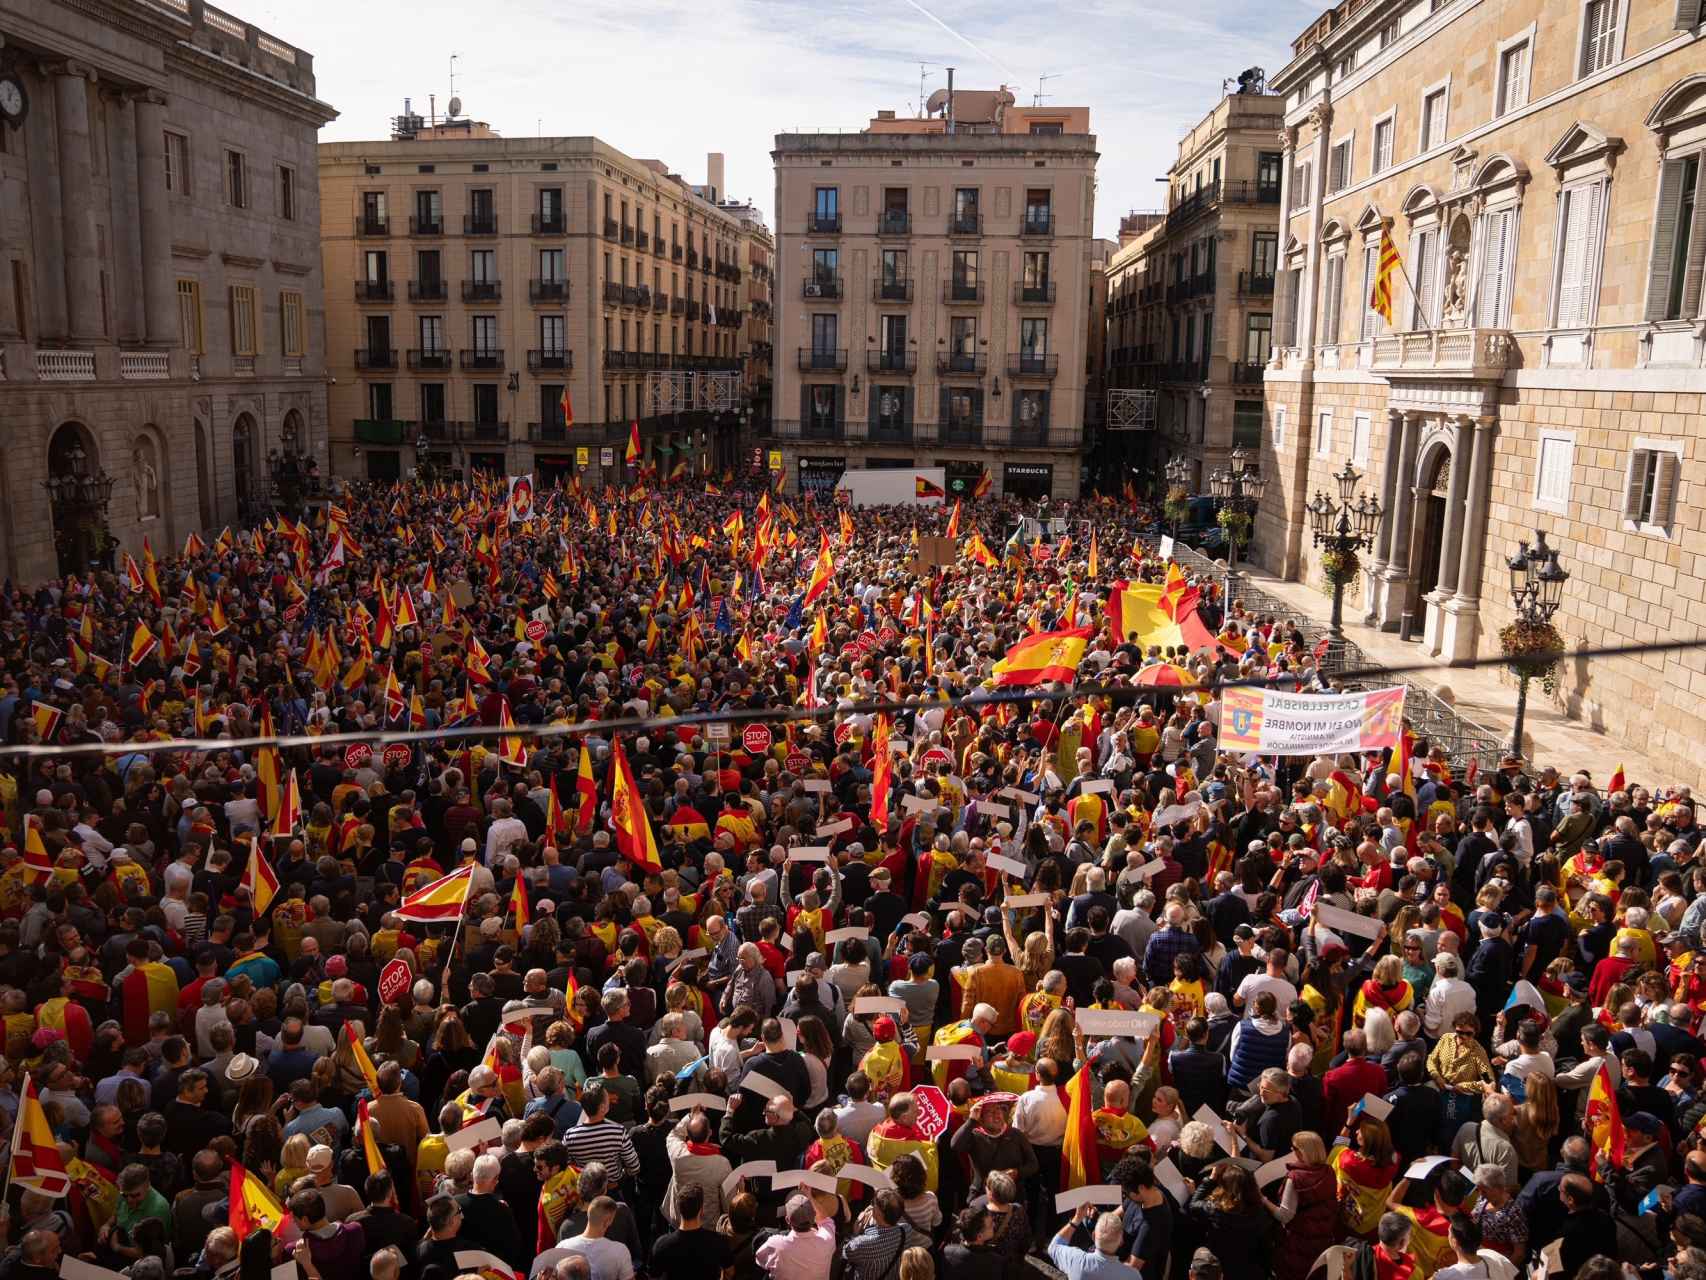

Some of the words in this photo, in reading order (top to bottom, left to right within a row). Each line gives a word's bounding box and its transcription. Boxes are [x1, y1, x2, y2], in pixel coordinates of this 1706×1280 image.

[527, 623, 543, 633] STOP
[746, 731, 768, 741] STOP
[347, 745, 368, 763] STOP
[385, 751, 408, 759] STOP
[381, 965, 405, 994] STOP
[915, 1106, 937, 1137] STO
